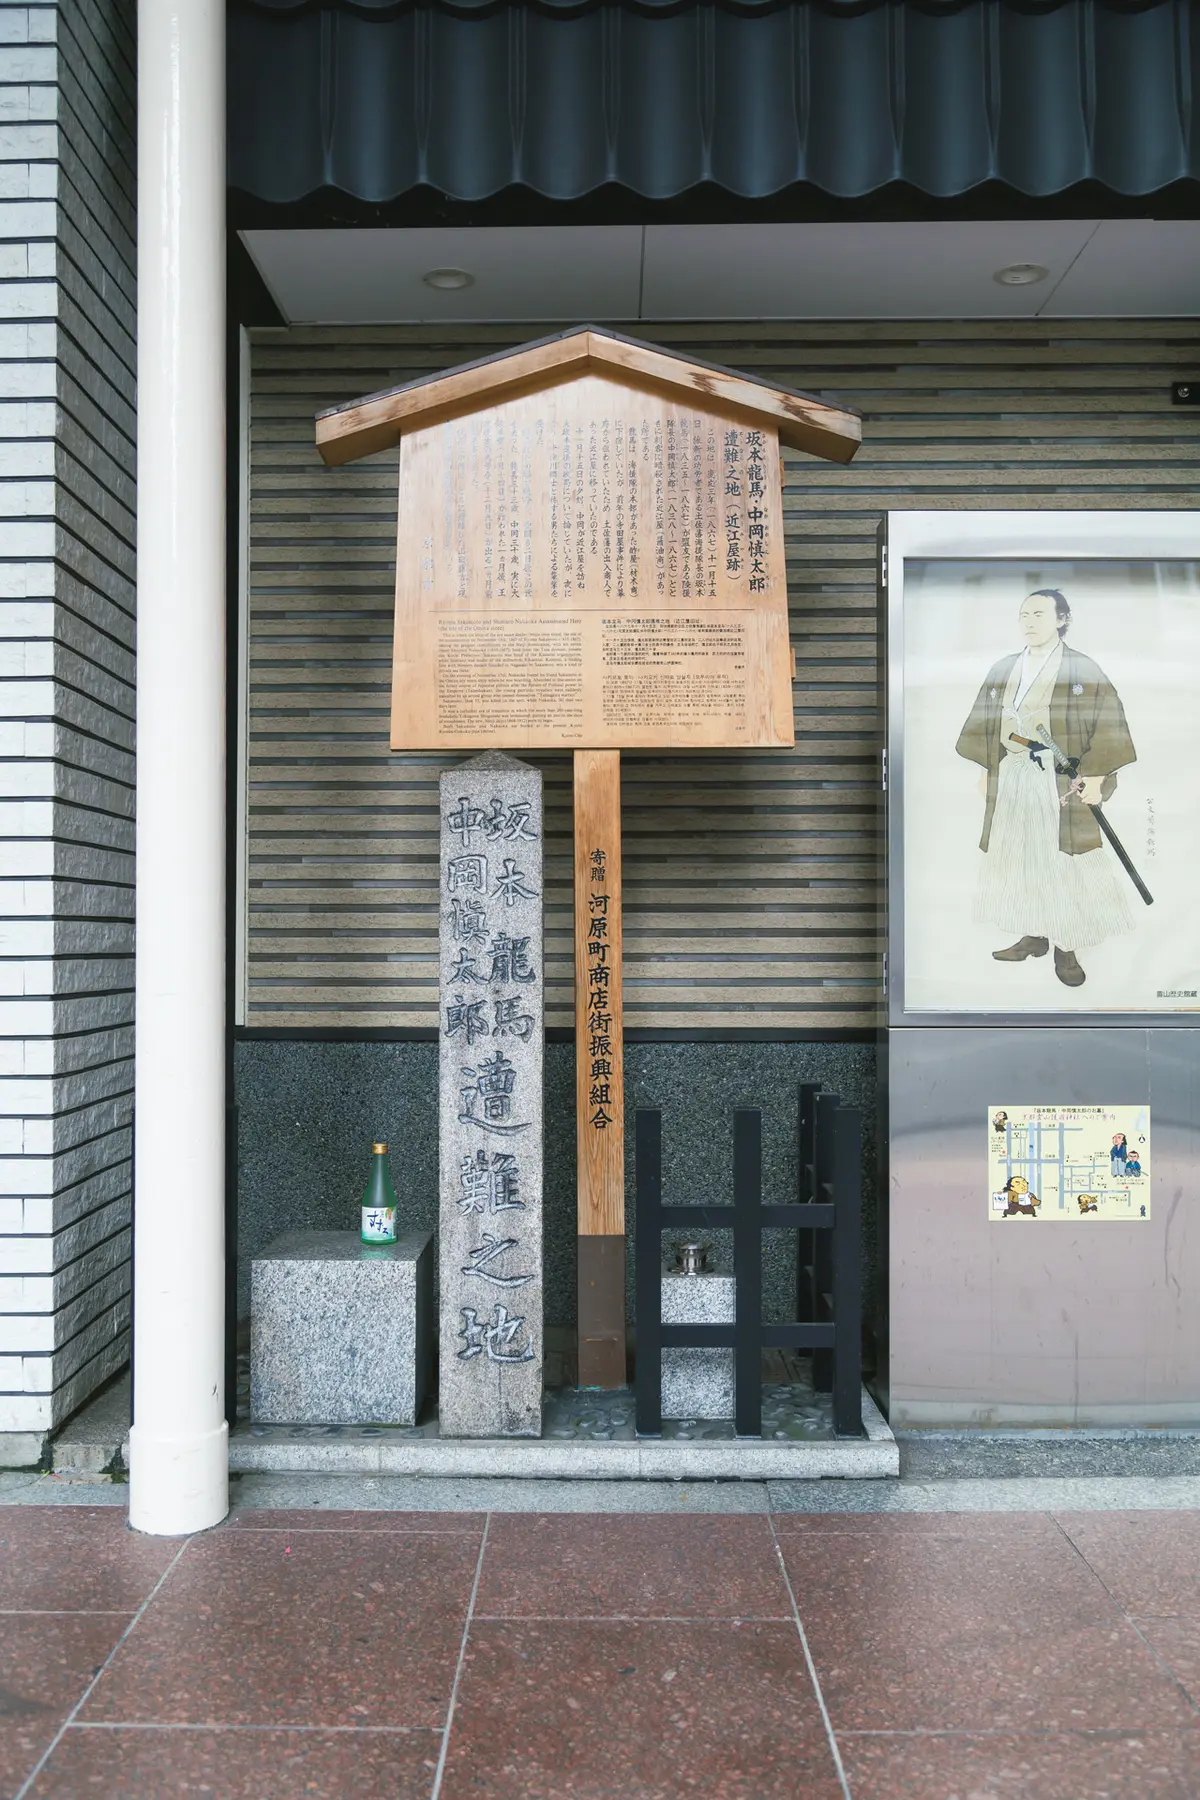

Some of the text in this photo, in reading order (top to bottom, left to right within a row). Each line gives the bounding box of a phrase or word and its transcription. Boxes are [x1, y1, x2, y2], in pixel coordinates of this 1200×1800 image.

[724, 428, 741, 580] 遭難之地（近江屋跡）
[746, 430, 765, 593] 坂本龍馬・中岡慎太郎
[485, 798, 539, 1044] 坂本龍馬
[589, 848, 606, 882] 寄贈
[588, 893, 613, 1131] 河原町商店街振興組合
[457, 1049, 536, 1364] 遭難之地
